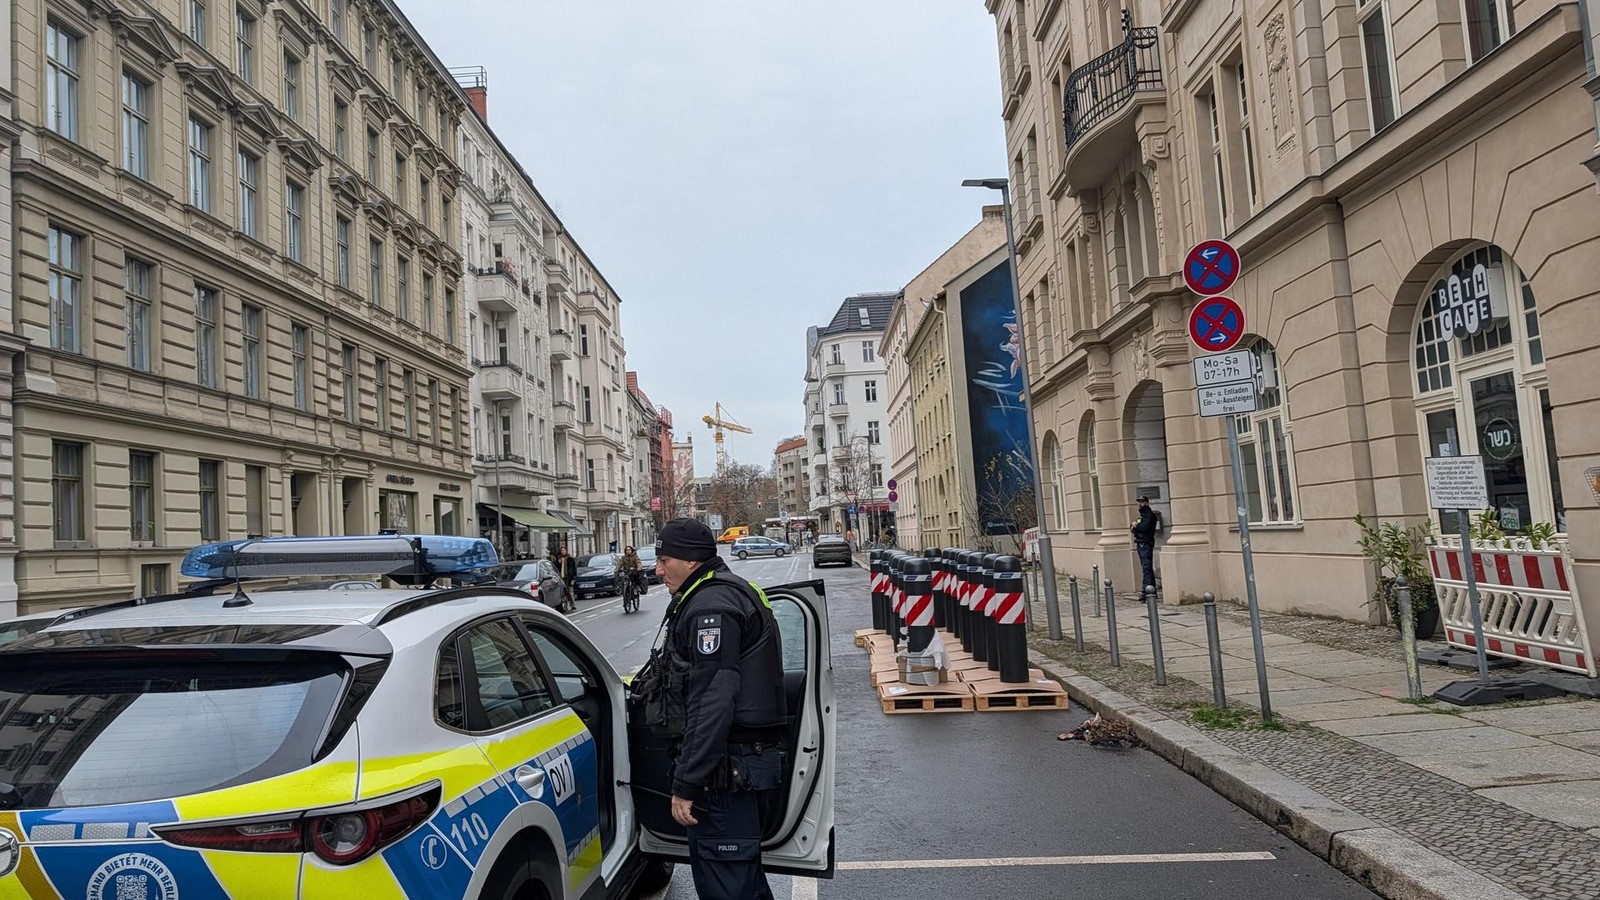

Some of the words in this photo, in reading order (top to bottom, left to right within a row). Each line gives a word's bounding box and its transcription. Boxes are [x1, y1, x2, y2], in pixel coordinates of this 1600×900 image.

[1438, 272, 1486, 308] BETH
[1443, 299, 1488, 331] CAFE
[1204, 356, 1238, 369] Mo-Sa
[1204, 368, 1240, 380] 07-17h
[1223, 394, 1253, 404] Aussteigen
[1224, 387, 1248, 395] Entladen
[1488, 429, 1511, 447] כשר
[550, 758, 574, 798] OV1
[451, 812, 489, 853] 110
[140, 858, 164, 876] MEHR
